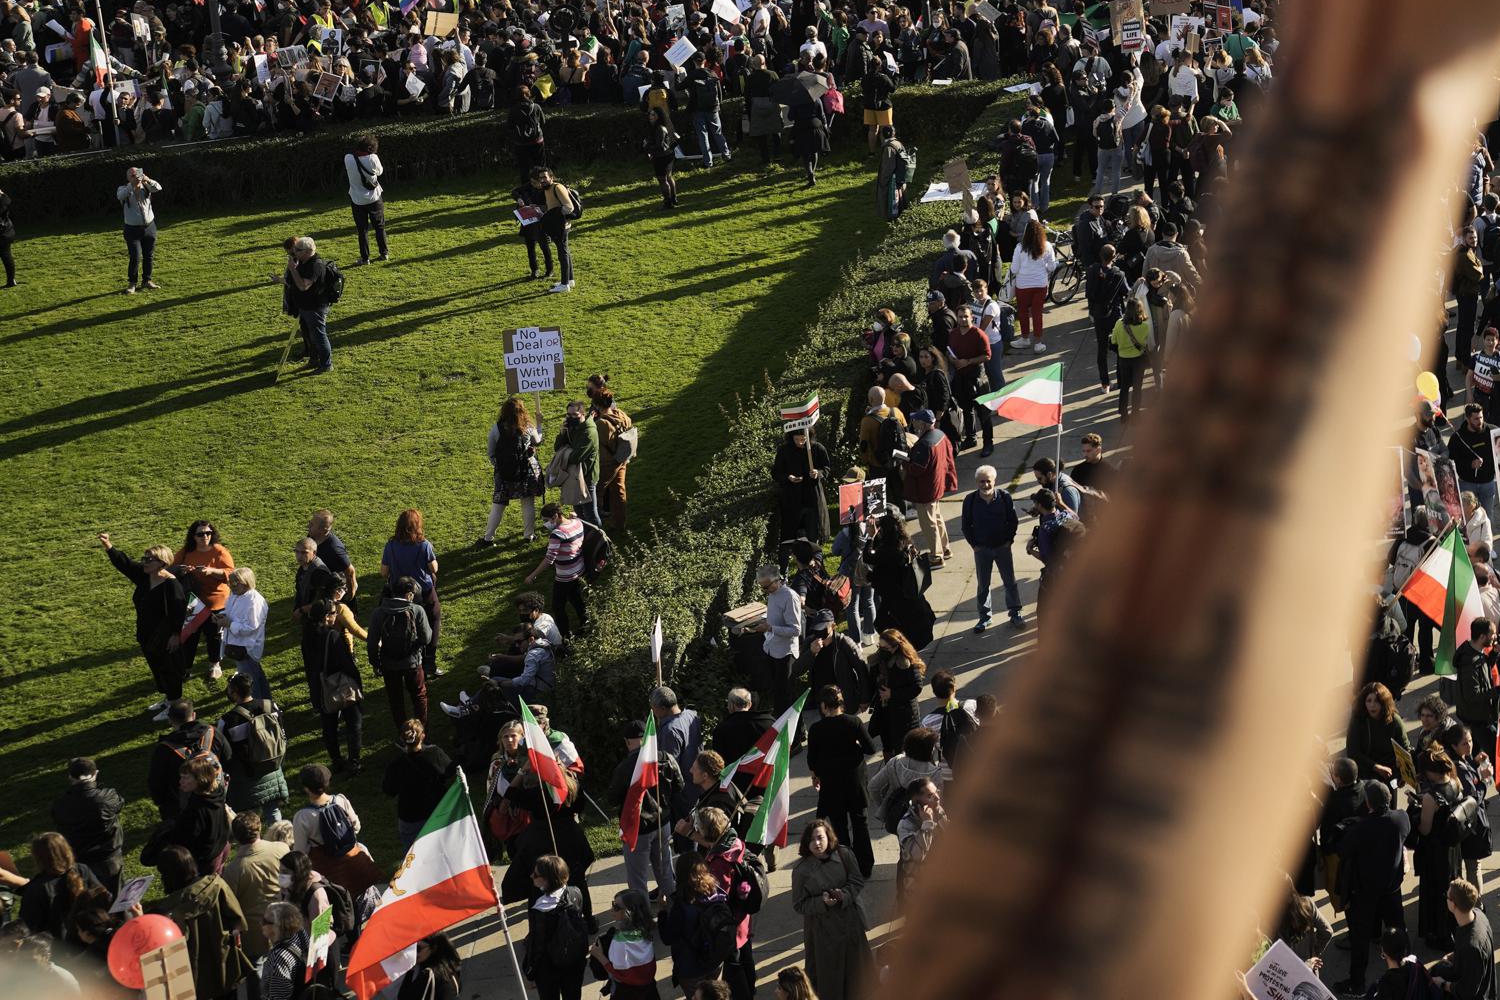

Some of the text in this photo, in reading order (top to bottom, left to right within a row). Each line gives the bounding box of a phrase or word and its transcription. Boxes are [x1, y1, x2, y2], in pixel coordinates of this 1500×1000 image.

[520, 330, 536, 340] No
[516, 340, 542, 350] Deal
[508, 352, 560, 366] Lobbying
[520, 366, 548, 378] With
[1480, 366, 1493, 376] LIF
[521, 378, 550, 390] Devil
[1259, 971, 1290, 994] PROTESTING
